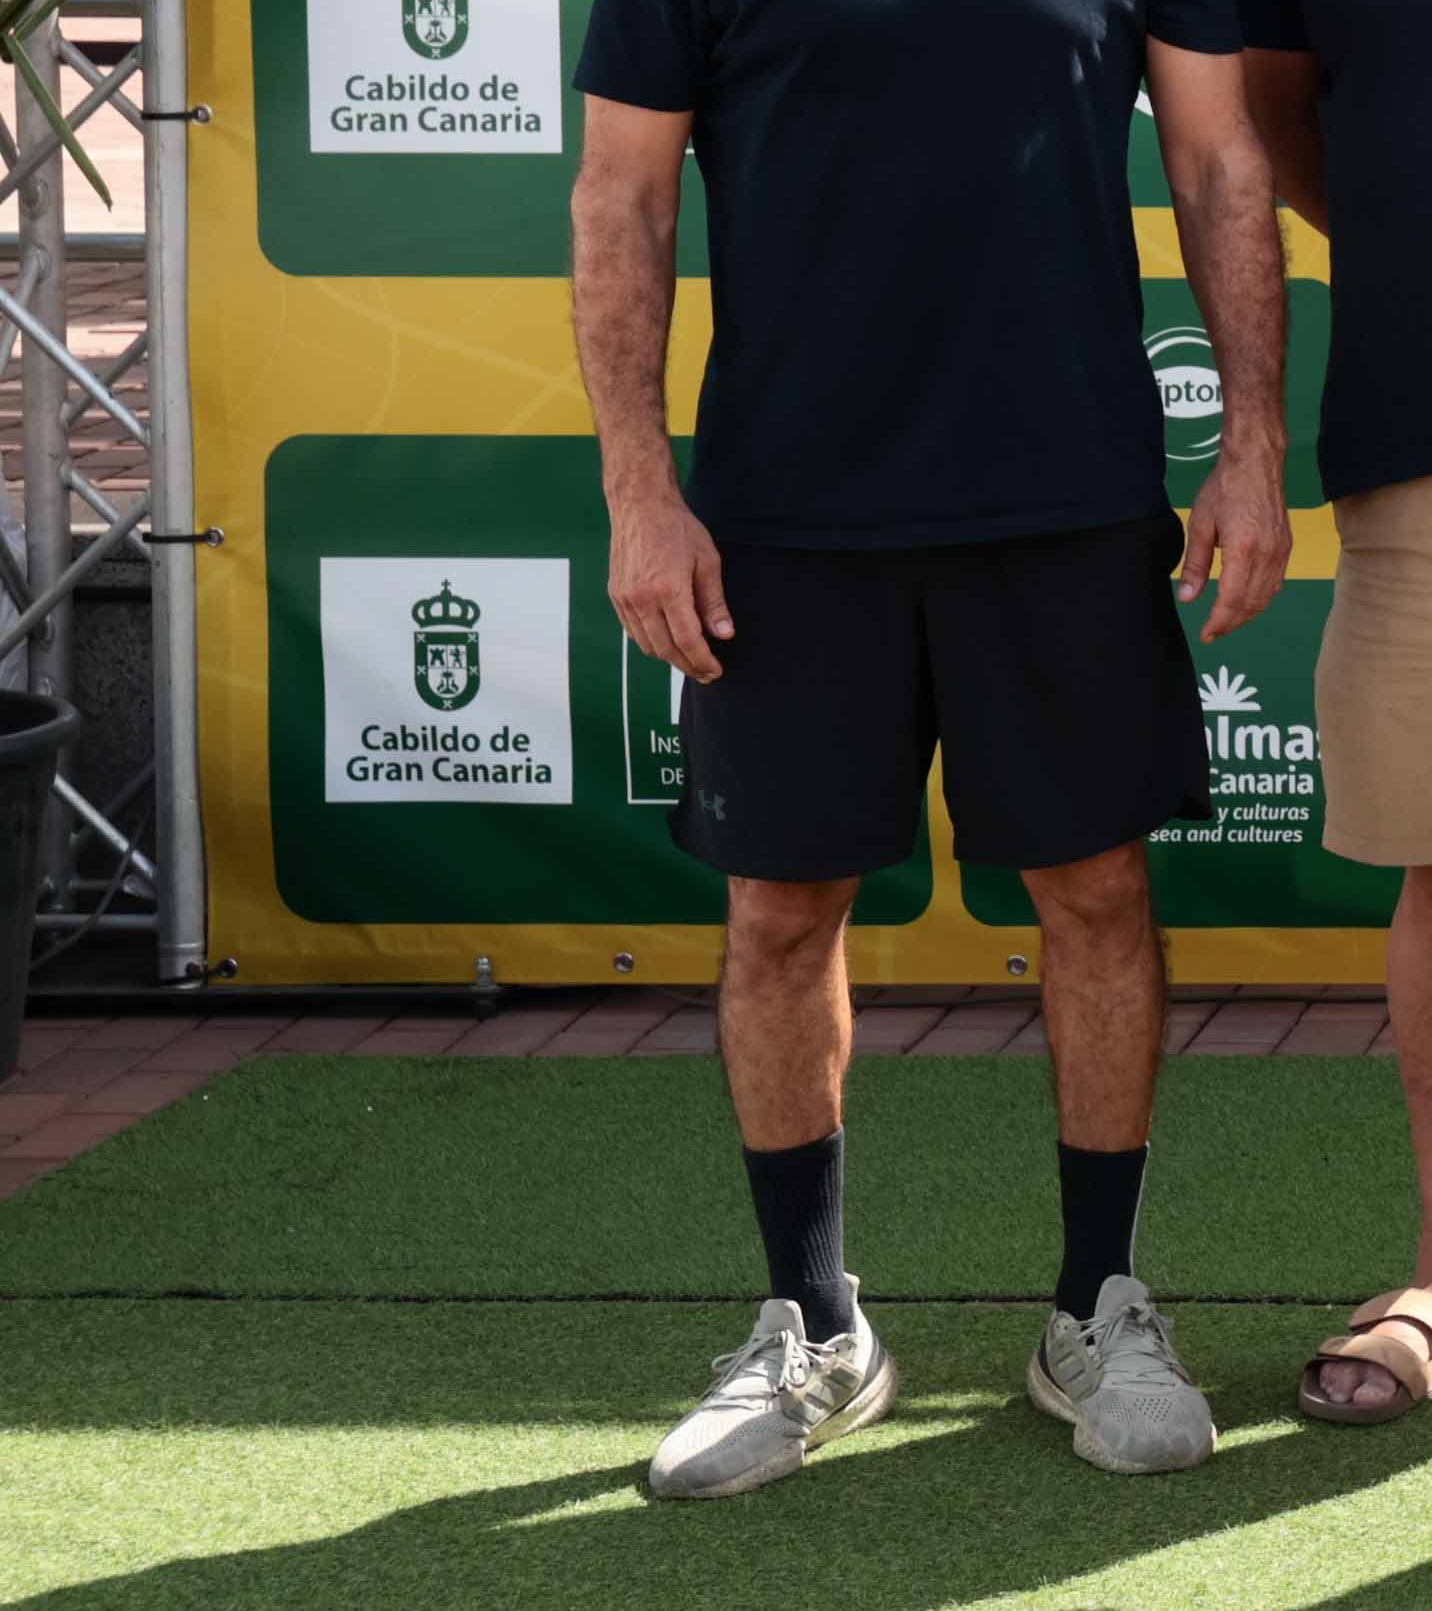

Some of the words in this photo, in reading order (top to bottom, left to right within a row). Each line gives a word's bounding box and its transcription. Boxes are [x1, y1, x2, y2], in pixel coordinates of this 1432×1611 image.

[344, 74, 469, 103] Cabildo
[479, 74, 518, 103] de
[331, 105, 408, 133] Gran
[418, 105, 541, 133] Canaria
[361, 725, 480, 753] Cabildo
[490, 725, 529, 753] de
[346, 755, 423, 783] Gran
[432, 756, 552, 785] Canaria
